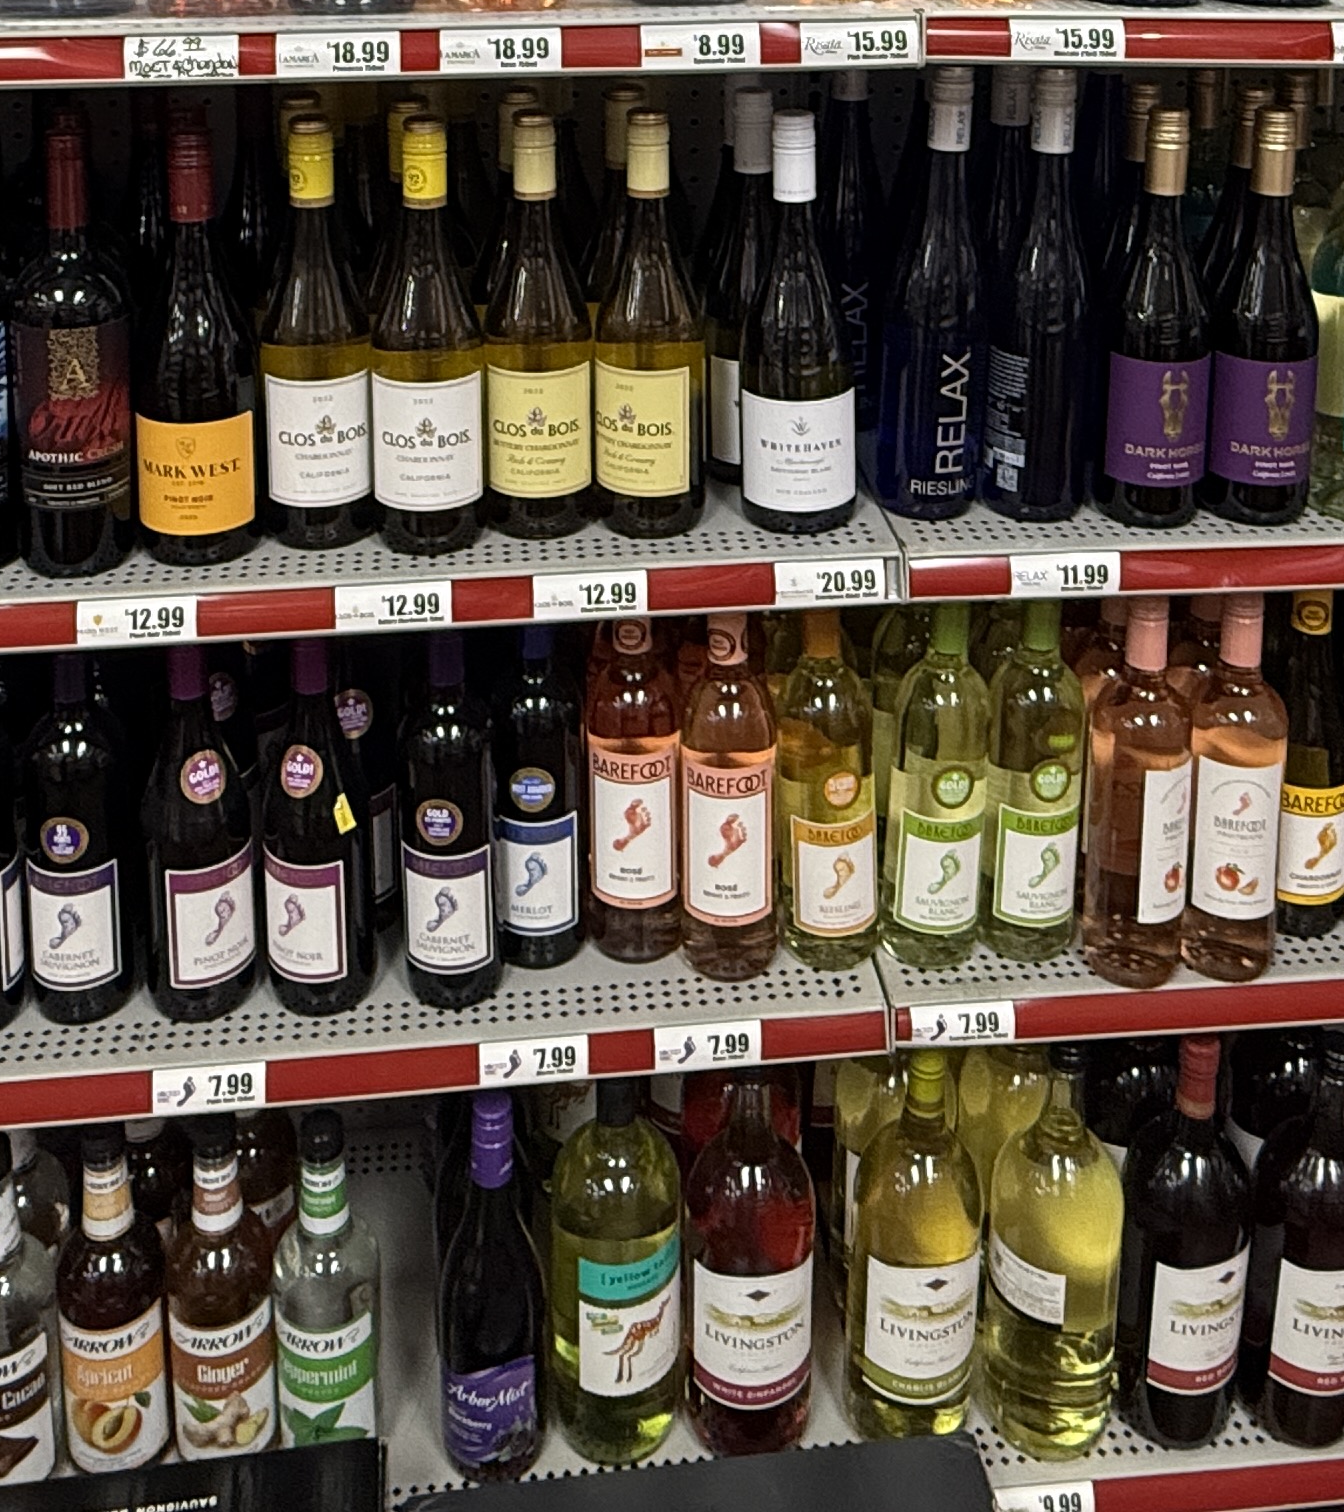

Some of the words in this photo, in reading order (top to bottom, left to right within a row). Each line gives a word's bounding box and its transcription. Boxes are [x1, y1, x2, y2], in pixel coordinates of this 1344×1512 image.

[935, 348, 972, 475] RELAX
[278, 430, 317, 447] CLOS
[493, 418, 529, 437] CLOS
[382, 430, 418, 449] CLOS
[1124, 442, 1166, 459] DARK
[1230, 440, 1271, 457] DARK
[28, 450, 84, 463] APOTHIC
[143, 459, 188, 480] MARK
[592, 753, 673, 780] BAREFOOT
[685, 767, 771, 794] BAREFOOT
[704, 1320, 806, 1351] LIVINGSTON
[76, 1362, 133, 1385] Apricot
[196, 1357, 250, 1385] Ginger
[0, 1372, 46, 1411] Cacao
